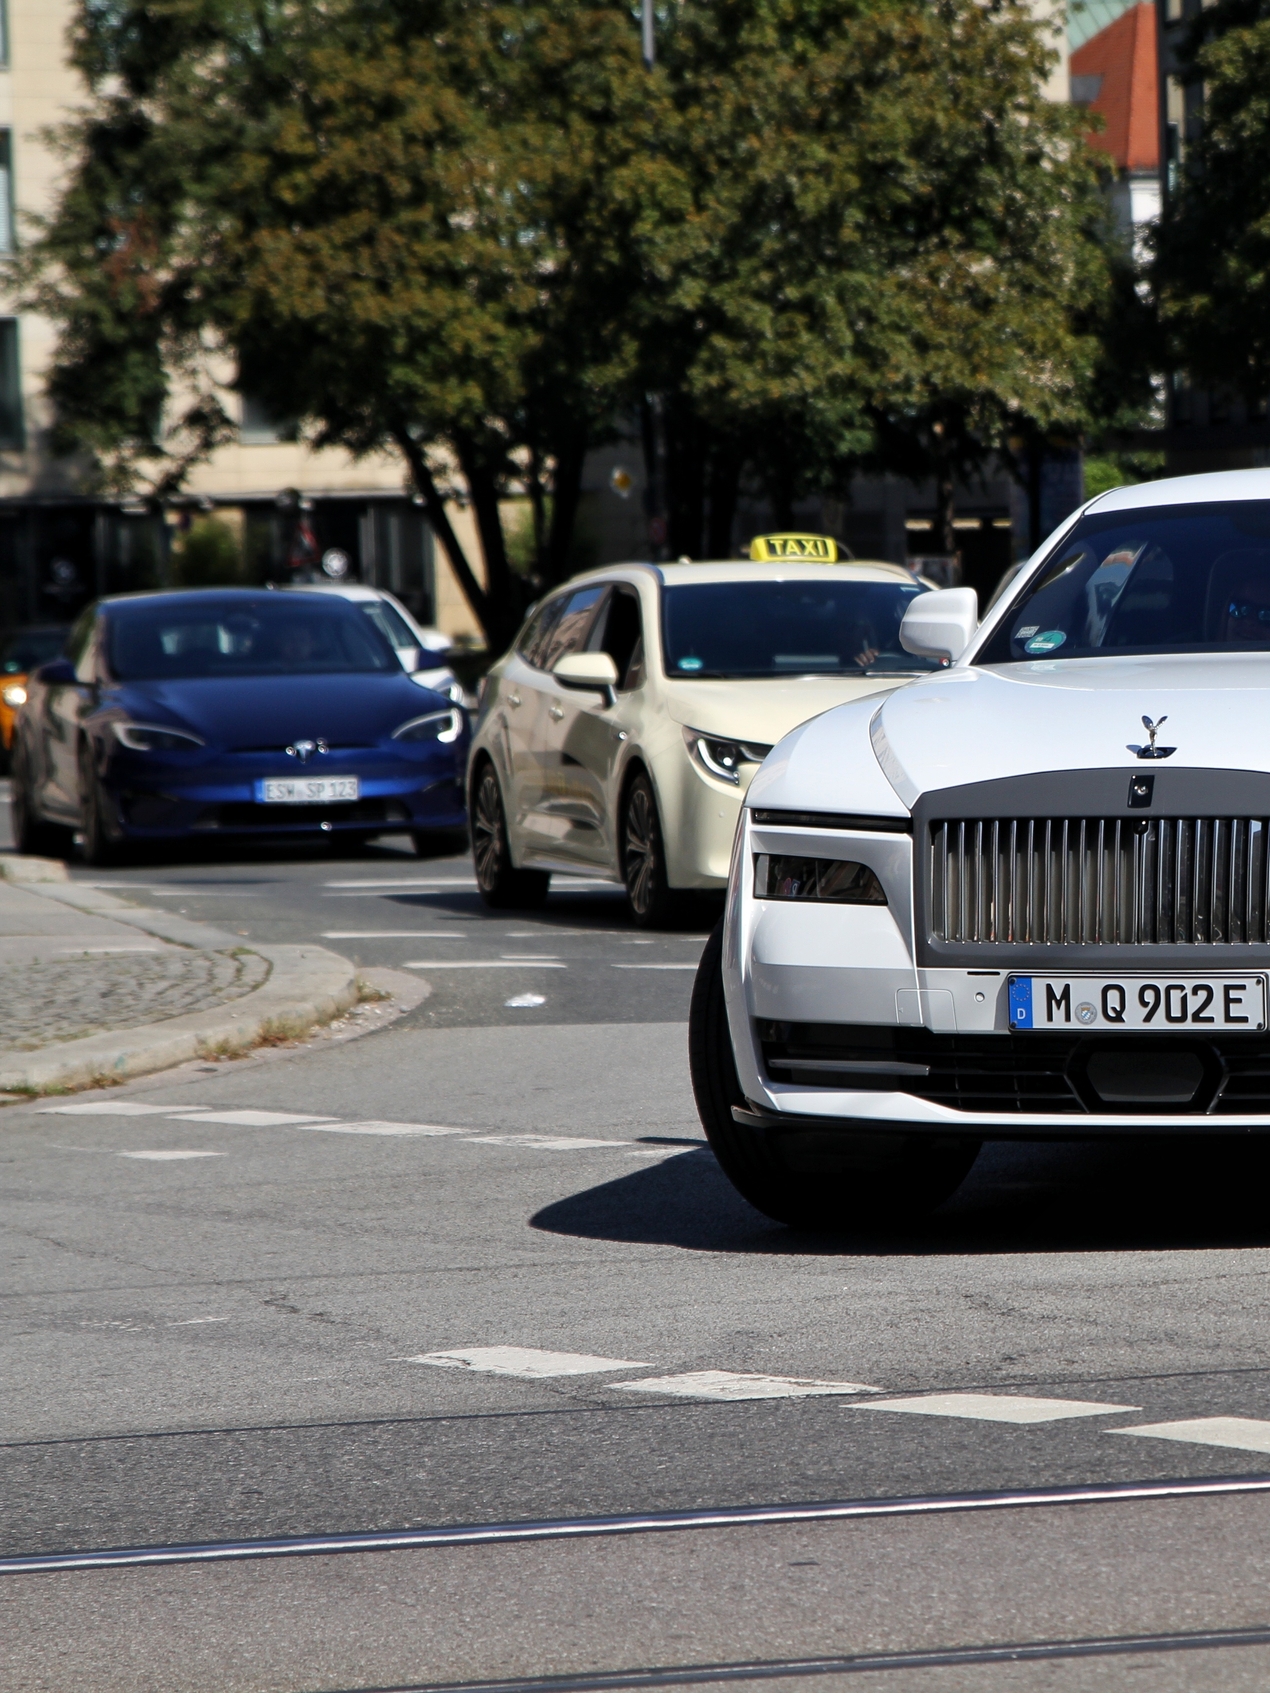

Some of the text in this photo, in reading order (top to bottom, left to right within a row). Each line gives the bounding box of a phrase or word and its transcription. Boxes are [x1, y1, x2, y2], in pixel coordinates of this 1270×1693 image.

[769, 539, 825, 556] TAXI
[328, 780, 356, 798] 123
[1017, 1008, 1026, 1020] D
[1046, 983, 1071, 1022] M
